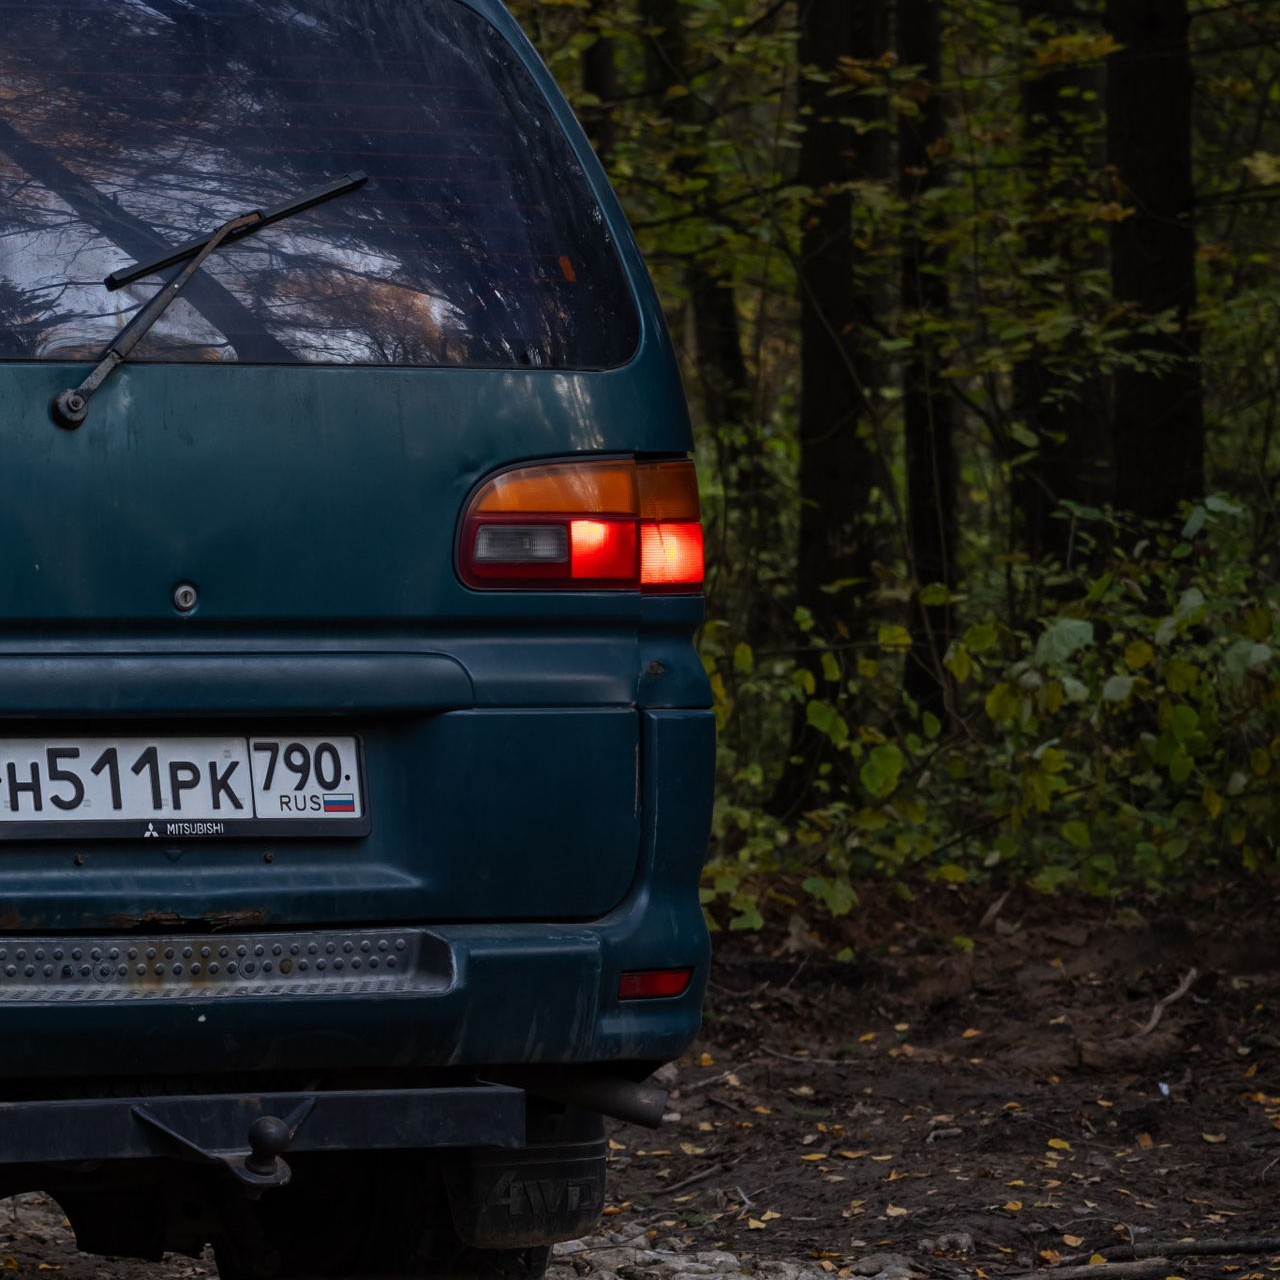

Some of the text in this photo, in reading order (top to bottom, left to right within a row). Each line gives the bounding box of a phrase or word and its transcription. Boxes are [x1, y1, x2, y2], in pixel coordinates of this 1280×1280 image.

[253, 742, 342, 791] 790
[279, 794, 322, 812] RUS
[166, 822, 224, 835] MITSUBISHI
[487, 1170, 602, 1216] 4WD
